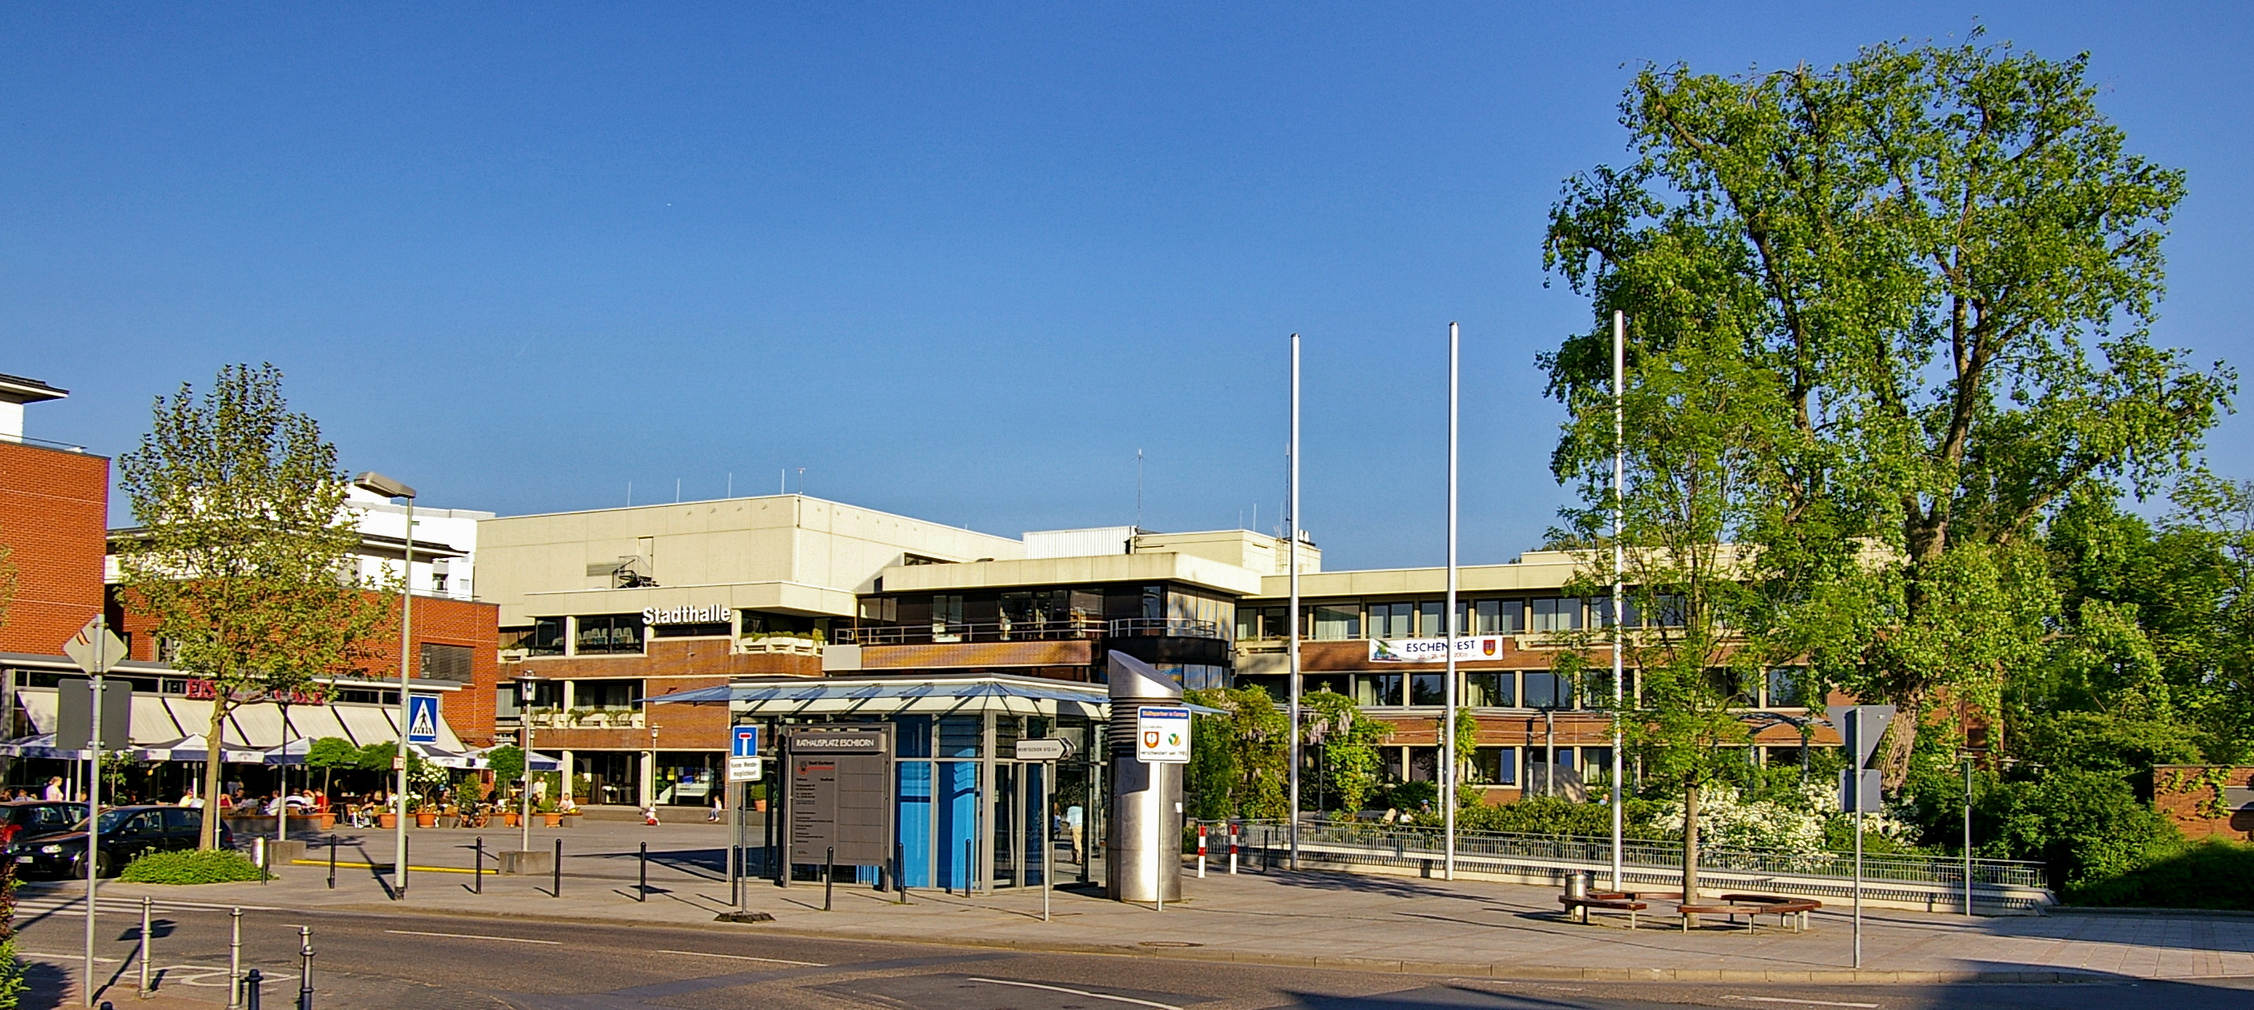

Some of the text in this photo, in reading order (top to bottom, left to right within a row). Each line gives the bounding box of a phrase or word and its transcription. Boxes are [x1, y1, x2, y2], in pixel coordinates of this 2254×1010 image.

[642, 604, 731, 625] Stadthalle
[1406, 640, 1475, 652] ESCHENEST
[187, 679, 217, 698] EIS
[796, 738, 874, 748] RATHAUSPLATZ ESCHBORN
